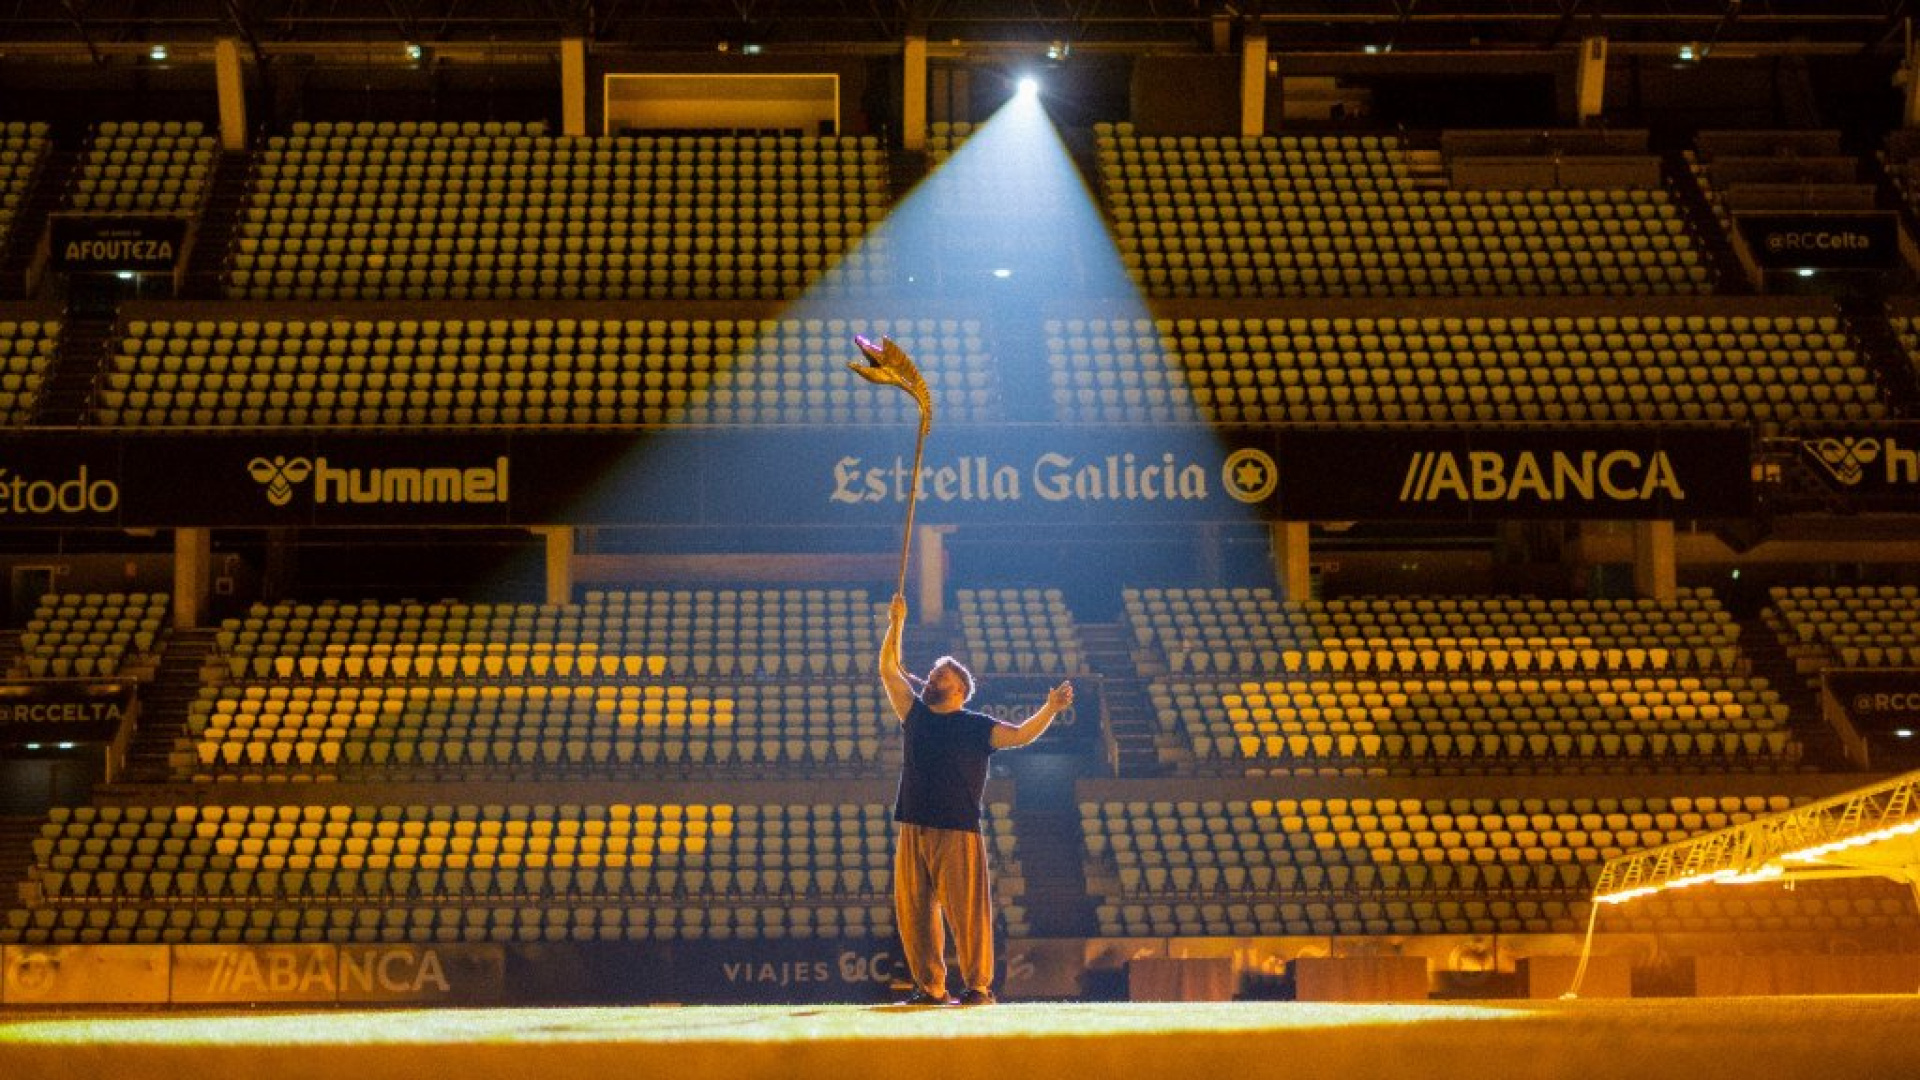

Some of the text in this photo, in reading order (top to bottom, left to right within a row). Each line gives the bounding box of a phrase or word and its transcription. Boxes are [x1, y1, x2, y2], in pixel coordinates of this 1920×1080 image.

[65, 240, 173, 260] AFOUTEZA
[315, 456, 509, 503] hummel
[829, 452, 1209, 503] Estrella Galicia
[723, 962, 830, 986] VIAJES
